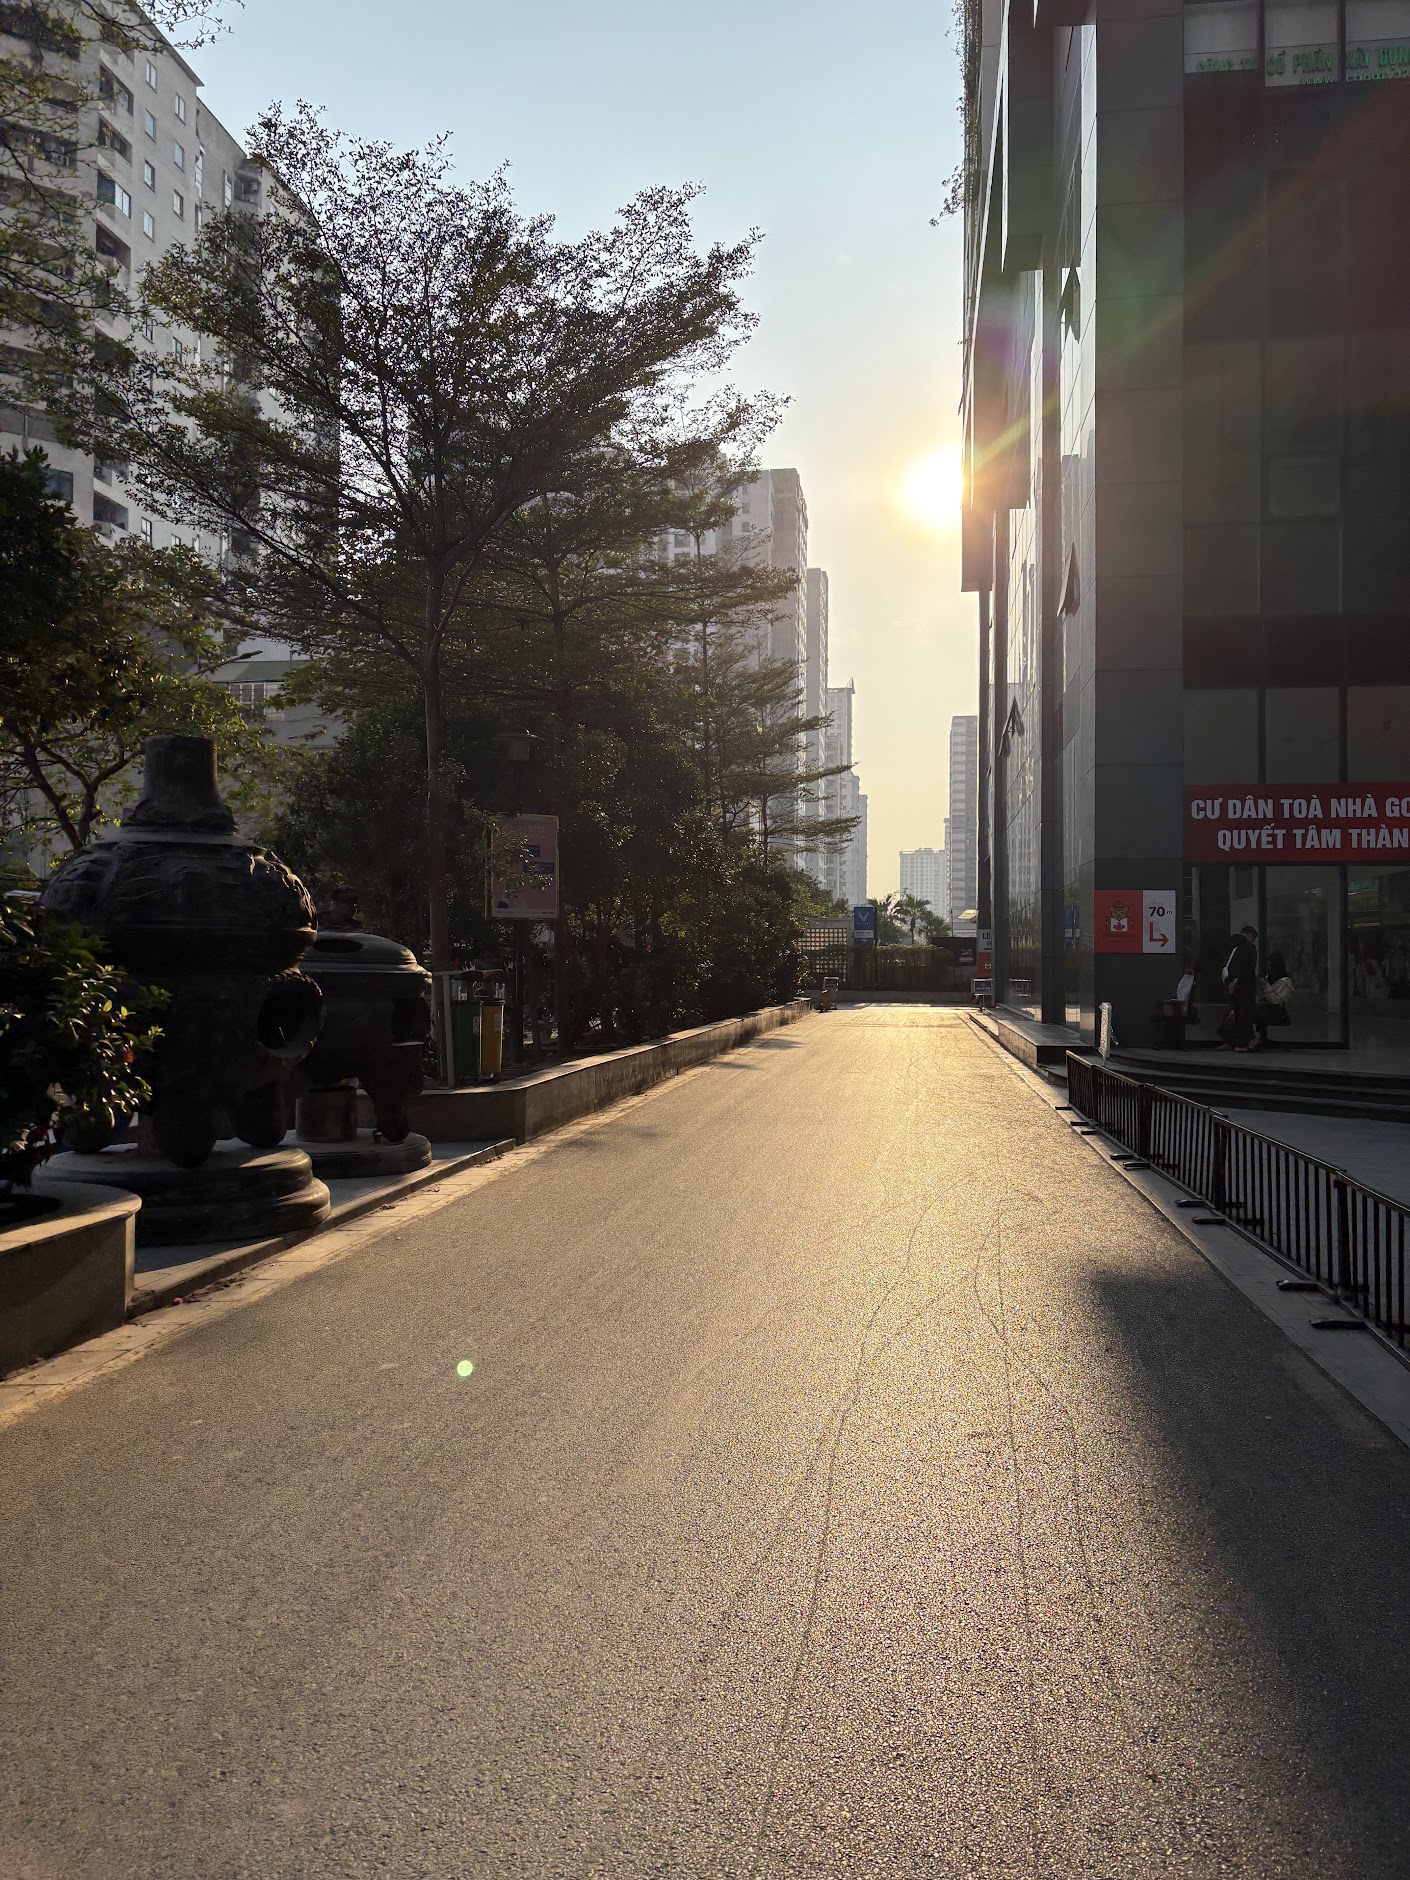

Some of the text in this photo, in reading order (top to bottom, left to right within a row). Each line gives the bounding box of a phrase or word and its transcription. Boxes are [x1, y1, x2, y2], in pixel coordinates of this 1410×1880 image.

[1191, 798, 1223, 820] CƯ
[1227, 795, 1274, 819] DÂN
[1280, 794, 1323, 819] TOÀ
[1330, 793, 1378, 818] NHÀ
[1217, 823, 1409, 852] QUYẾT TÂM THÀN
